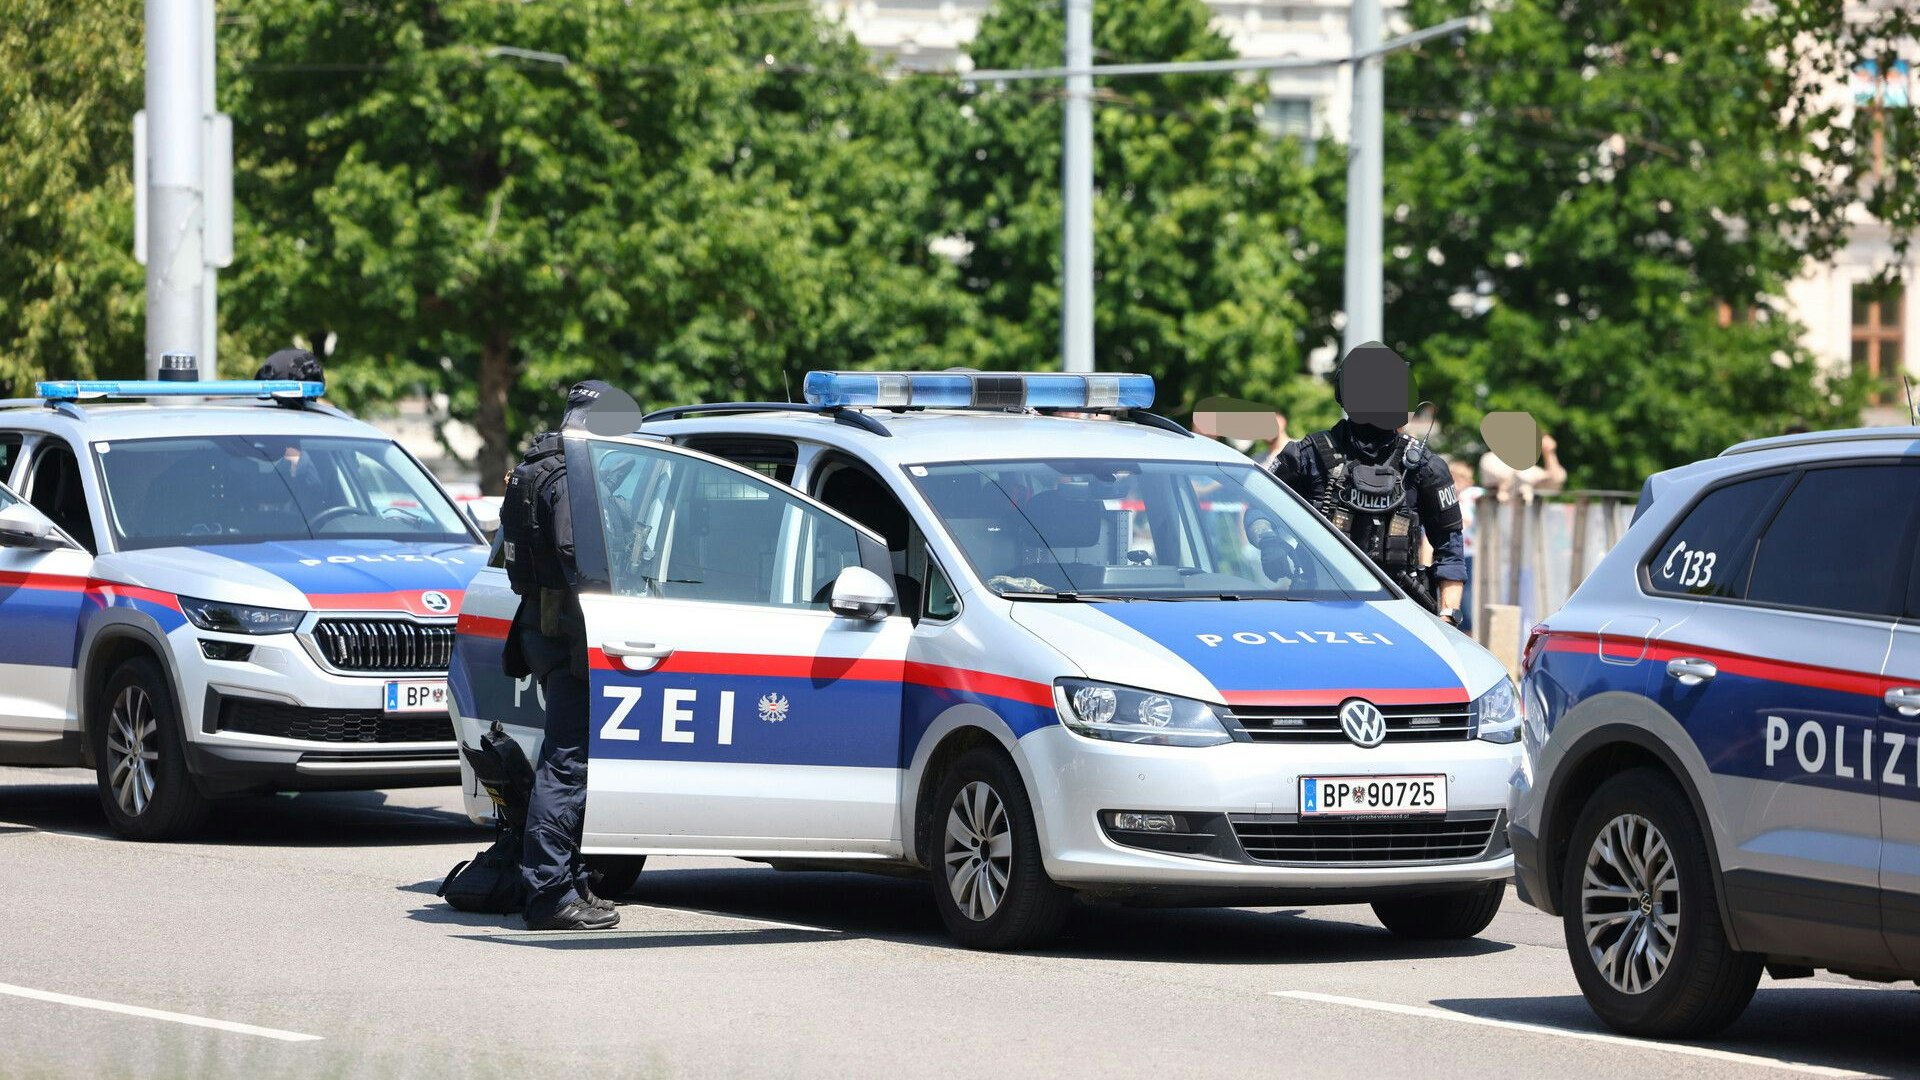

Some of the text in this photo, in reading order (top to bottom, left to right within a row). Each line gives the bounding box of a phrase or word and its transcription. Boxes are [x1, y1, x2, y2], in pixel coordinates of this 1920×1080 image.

[299, 554, 465, 567] POLIZEI
[1679, 550, 1717, 588] 133
[1196, 631, 1394, 648] POLIZEI
[407, 686, 430, 707] BP
[600, 685, 735, 745] ZEI
[1765, 715, 1920, 789] POLIZ
[1324, 783, 1350, 808] BP
[1367, 782, 1435, 807] 90725
